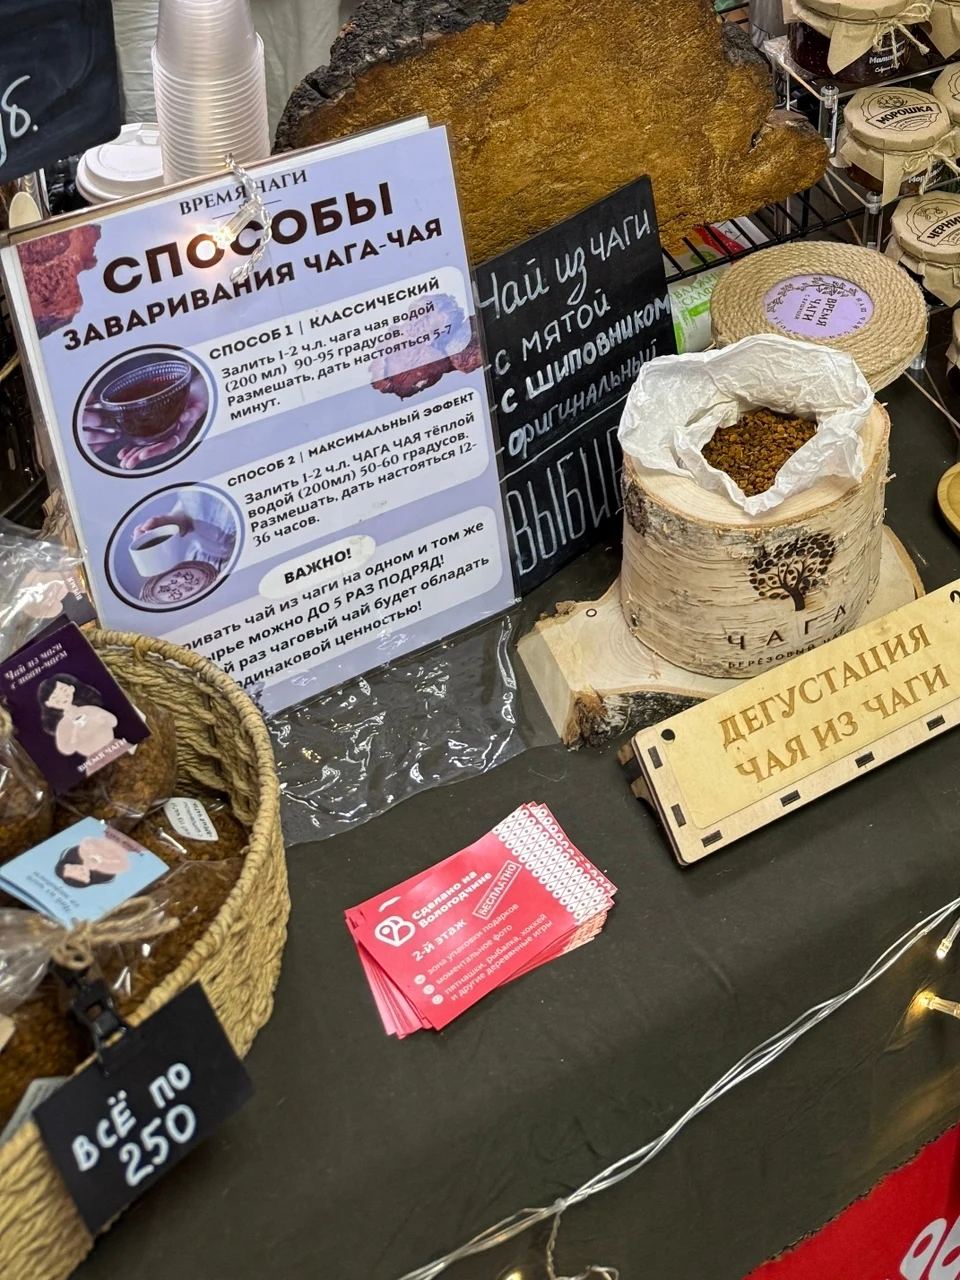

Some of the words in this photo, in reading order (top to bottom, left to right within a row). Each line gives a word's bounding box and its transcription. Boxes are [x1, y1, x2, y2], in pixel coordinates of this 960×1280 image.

[875, 104, 934, 124] МОРОШКА
[102, 182, 394, 294] СПОСОБЫ
[179, 186, 248, 216] ВРЕМЯ
[63, 261, 295, 351] ЗАВАРИВАНИЯ
[304, 218, 443, 275] ЧАГА-ЧАЯ
[472, 260, 550, 320] Чай
[557, 246, 587, 306] из
[590, 209, 652, 262] ЧАГИ
[209, 328, 282, 360] СПОСОБ
[309, 276, 440, 329] КЛАССИЧЕСКИЙ
[221, 354, 276, 379] Залить
[330, 328, 361, 346] чага
[364, 318, 390, 334] чая
[392, 301, 435, 325] водой
[525, 292, 671, 402] ШИПОВНИКОМ
[801, 298, 822, 322] ЧАГИ
[816, 298, 837, 326] ВРЕМЯ
[224, 372, 258, 394] (200
[294, 350, 334, 371] 90-95
[337, 329, 404, 358] градусов.
[227, 373, 315, 407] Размешать,
[317, 362, 350, 380] дать
[353, 332, 431, 366] настояться
[227, 461, 286, 488] СПОСОБ
[308, 409, 420, 459] МАКСИМАЛЬНЫЙ
[423, 392, 475, 418] ЭФФЕКТ
[230, 398, 281, 422] минут.
[244, 478, 300, 506] Залить
[352, 444, 391, 464] ЧАГА
[392, 433, 422, 450] ЧАЯ
[425, 412, 475, 438] тёплой
[248, 492, 296, 518] водой
[298, 469, 356, 501] (200мл)
[360, 454, 400, 477] 50-60
[402, 432, 470, 462] градусов.
[250, 493, 339, 533] Размешать,
[341, 481, 375, 501] дать
[378, 451, 456, 485] настояться
[274, 515, 320, 537] часов.
[244, 606, 276, 624] чай
[302, 582, 340, 604] чаги
[365, 550, 414, 578] одном
[431, 532, 460, 550] том
[248, 616, 304, 644] можно
[346, 584, 375, 603] РАЗ
[378, 554, 445, 590] ПОДРЯД!
[283, 548, 352, 585] ВАЖНО!
[238, 650, 266, 670] раз
[270, 618, 339, 654] чаговый
[342, 604, 371, 624] чай
[374, 586, 418, 612] будет
[420, 557, 490, 591] обладать
[334, 600, 423, 646] ценностью!
[727, 604, 846, 650] ЧАГА
[718, 622, 933, 751] ДЕГУСТАЦИЯ
[734, 734, 810, 784] ЧАЯ
[810, 711, 859, 751] ИЗ
[862, 663, 952, 722] ЧАГИ
[412, 883, 462, 920] Сделано
[418, 872, 493, 929] Вологодчине
[478, 862, 517, 916] БЕСПЛАТНО
[521, 913, 548, 937] хоккей
[427, 960, 448, 976] зона
[446, 931, 484, 964] упаковки
[484, 902, 520, 934] подарков
[436, 918, 468, 946] этаж
[436, 941, 492, 986] моментальное
[493, 924, 514, 945] фото
[458, 972, 487, 998] другие
[486, 937, 533, 975] деревянные
[532, 921, 554, 942] игры
[72, 1089, 138, 1172] ВСЁ
[119, 1104, 197, 1187] 250
